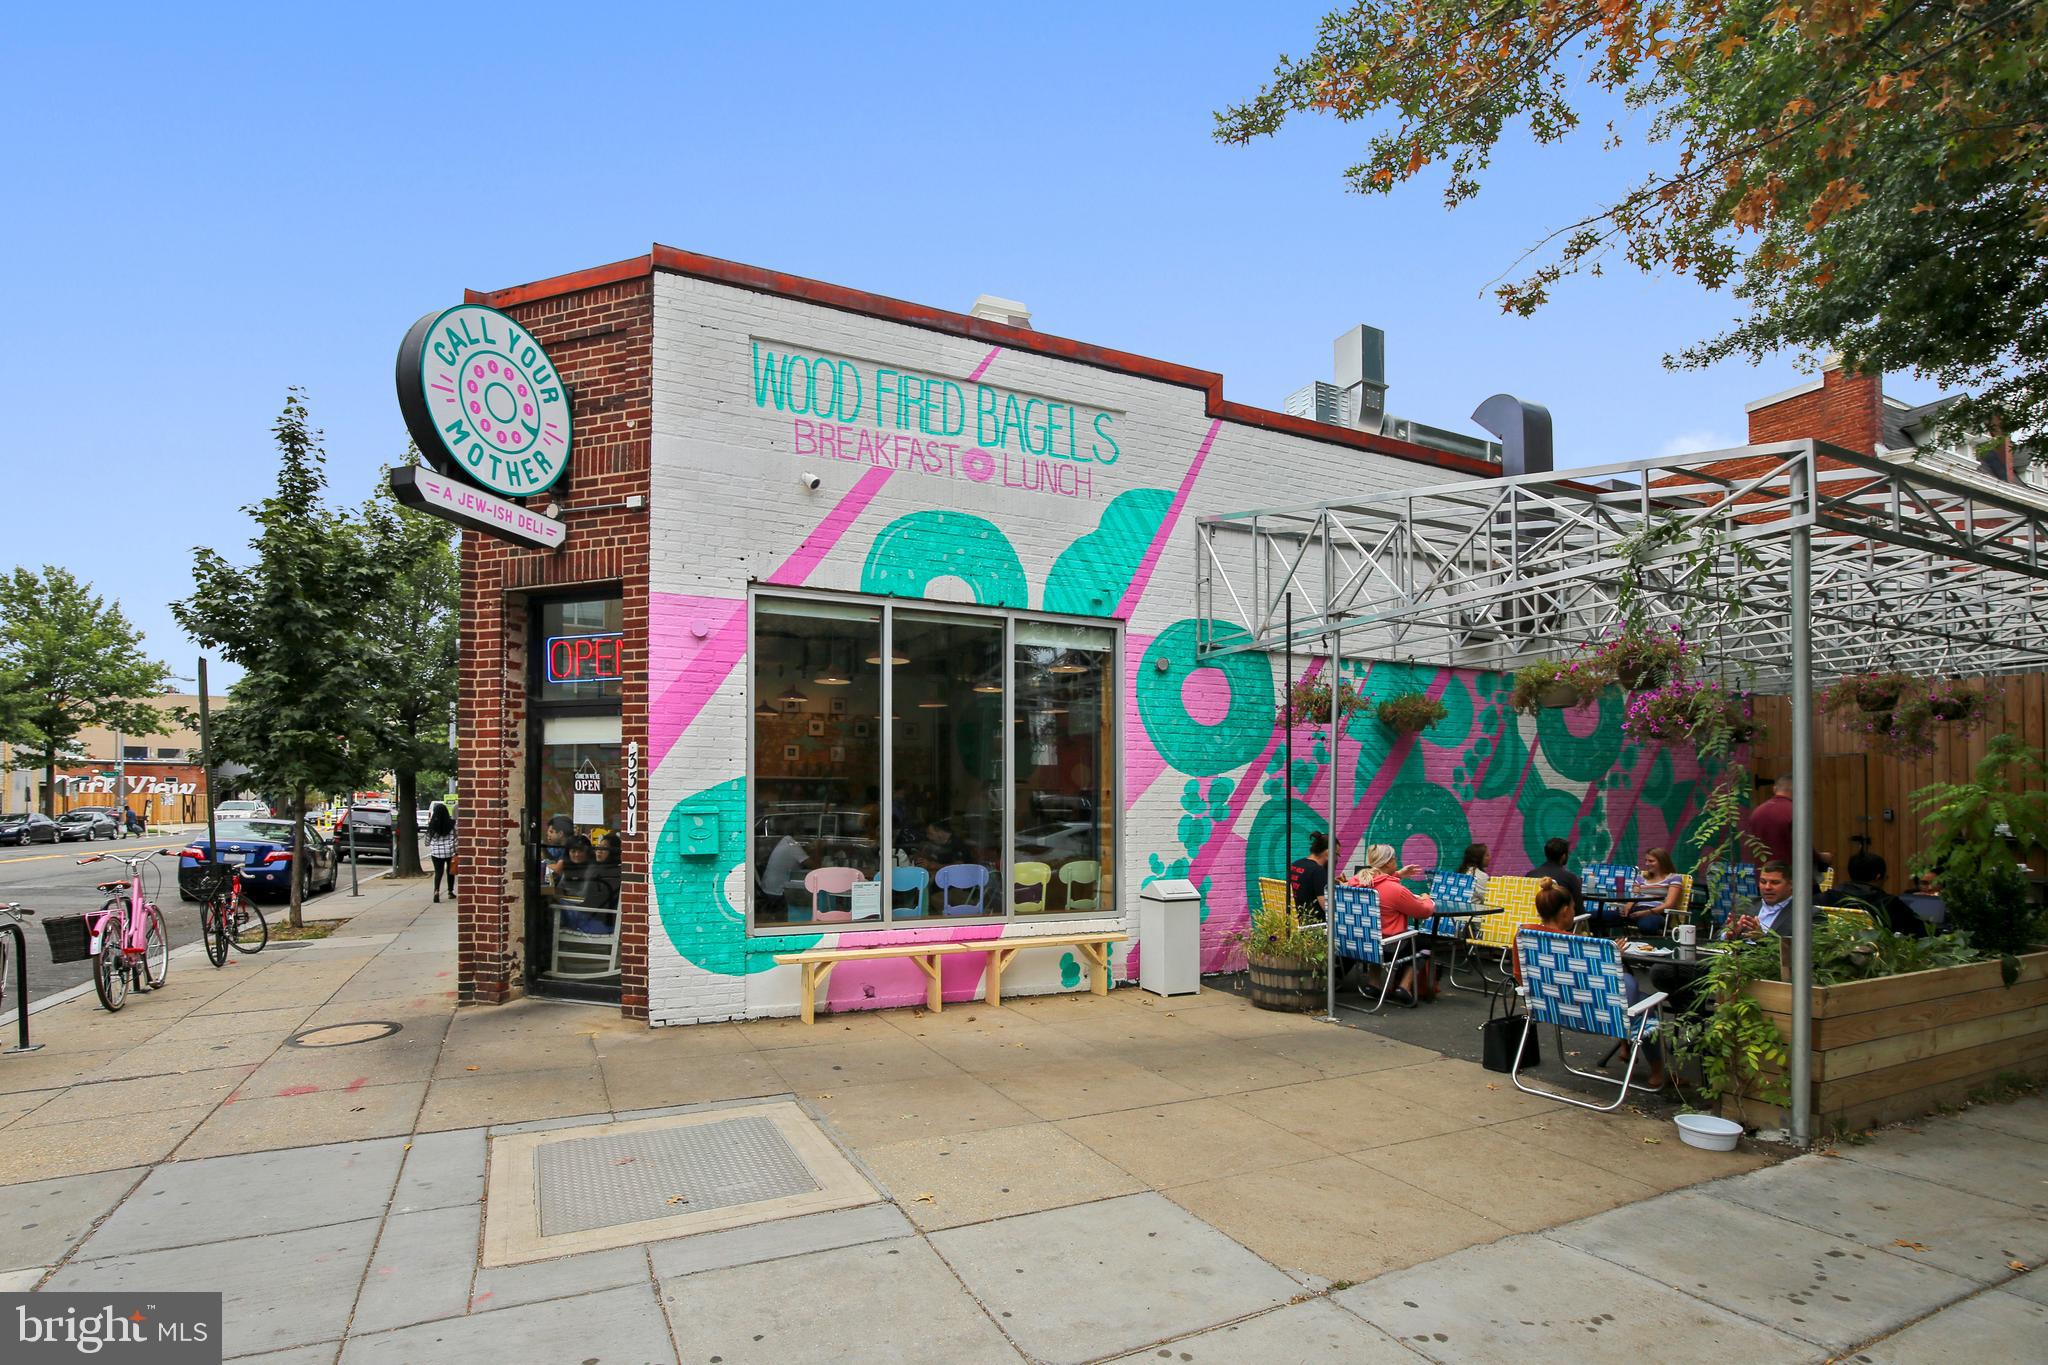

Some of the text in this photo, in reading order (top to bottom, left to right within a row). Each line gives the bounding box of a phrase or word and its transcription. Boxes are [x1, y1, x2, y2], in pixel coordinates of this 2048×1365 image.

[434, 316, 560, 404] CALL YOUR
[753, 342, 1120, 465] WOOD FIRED BAGELS
[445, 419, 552, 486] MOTHER
[794, 418, 1092, 499] BREAKFAST LUNCH
[443, 487, 543, 535] A JEW-ISH DELI
[125, 776, 197, 795] View
[575, 780, 600, 791] OPEN
[627, 752, 637, 832] 3301
